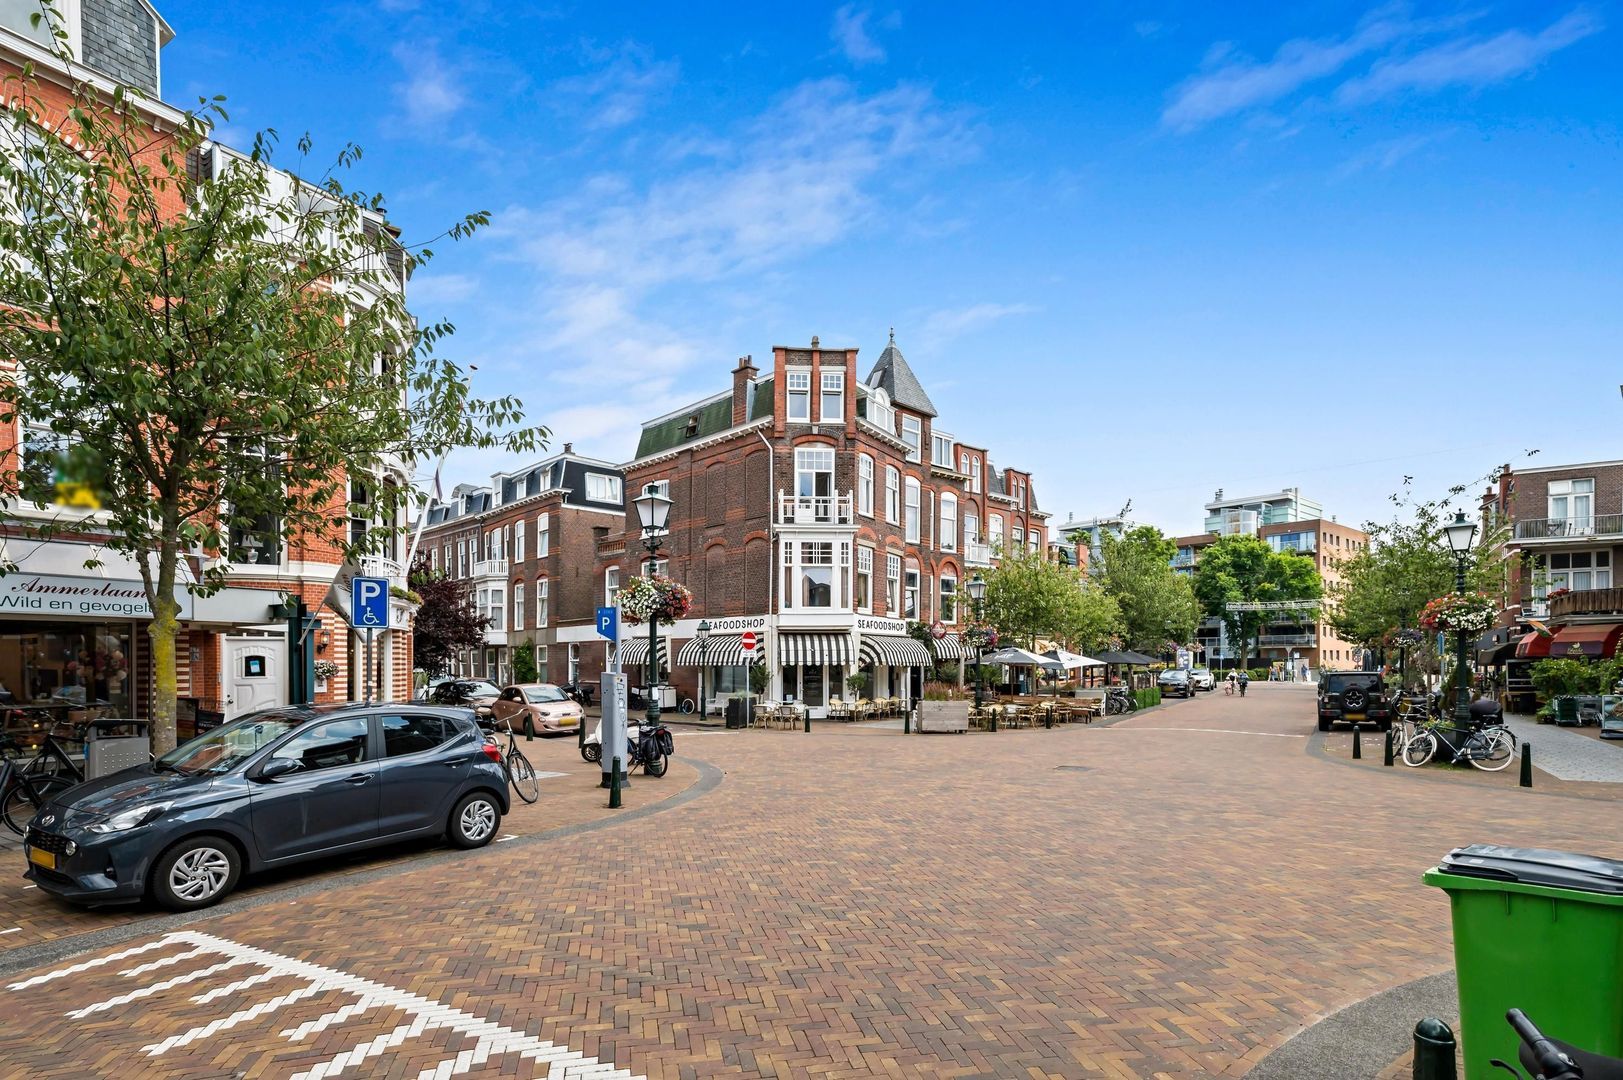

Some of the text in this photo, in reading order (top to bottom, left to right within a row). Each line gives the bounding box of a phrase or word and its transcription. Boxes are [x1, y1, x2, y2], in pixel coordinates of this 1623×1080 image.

[11, 577, 147, 599] Ammerlaan
[361, 582, 380, 606] P
[0, 595, 42, 609] Wild
[49, 600, 72, 610] en
[602, 616, 610, 630] P
[708, 618, 765, 630] EAFOODSHOP
[857, 619, 905, 632] SEAFOODSHOP
